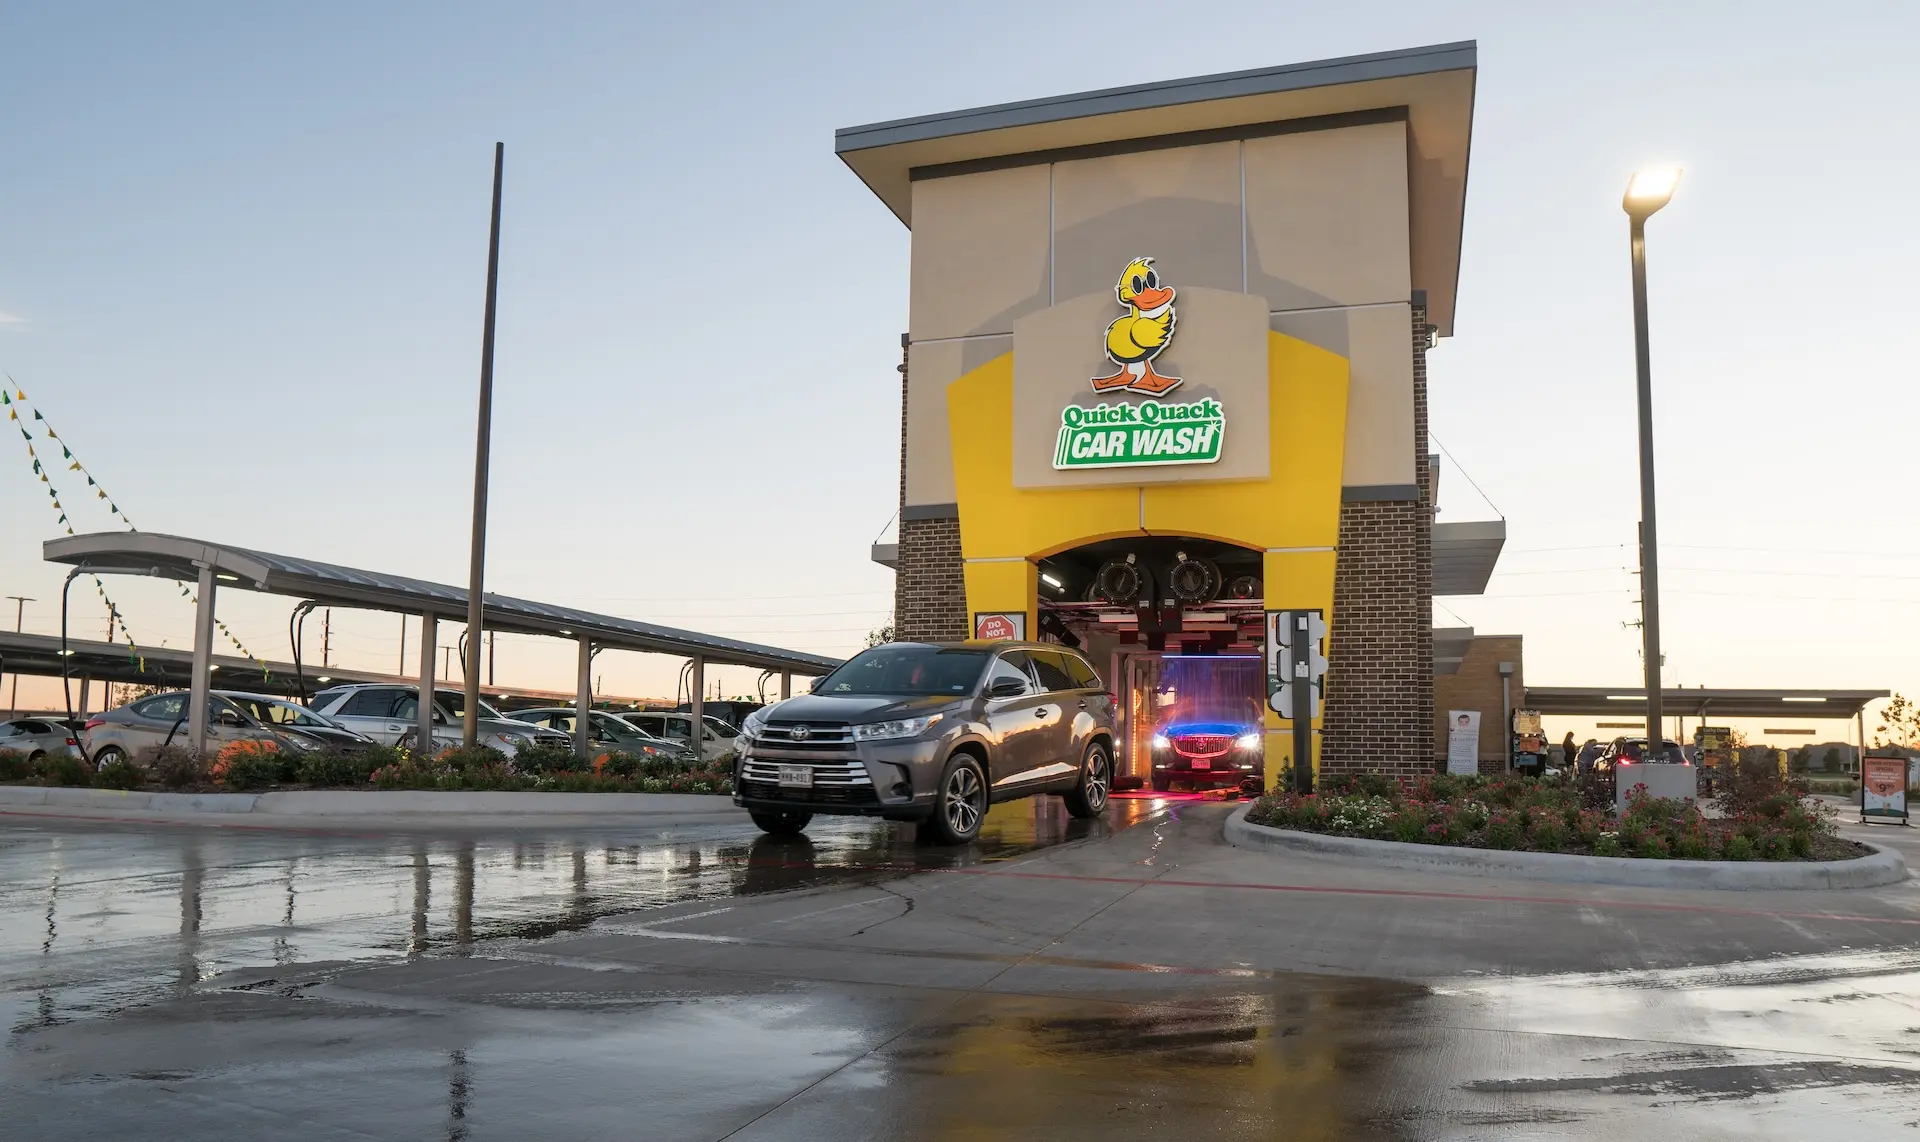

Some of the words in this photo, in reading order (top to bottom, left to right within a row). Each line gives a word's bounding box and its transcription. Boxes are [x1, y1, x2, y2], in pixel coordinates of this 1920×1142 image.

[1064, 402, 1137, 428] Quick
[1140, 400, 1221, 426] Quack
[1071, 431, 1127, 459] CAR
[1132, 427, 1215, 456] WASH
[986, 628, 1005, 638] NOT
[987, 620, 1001, 629] DO
